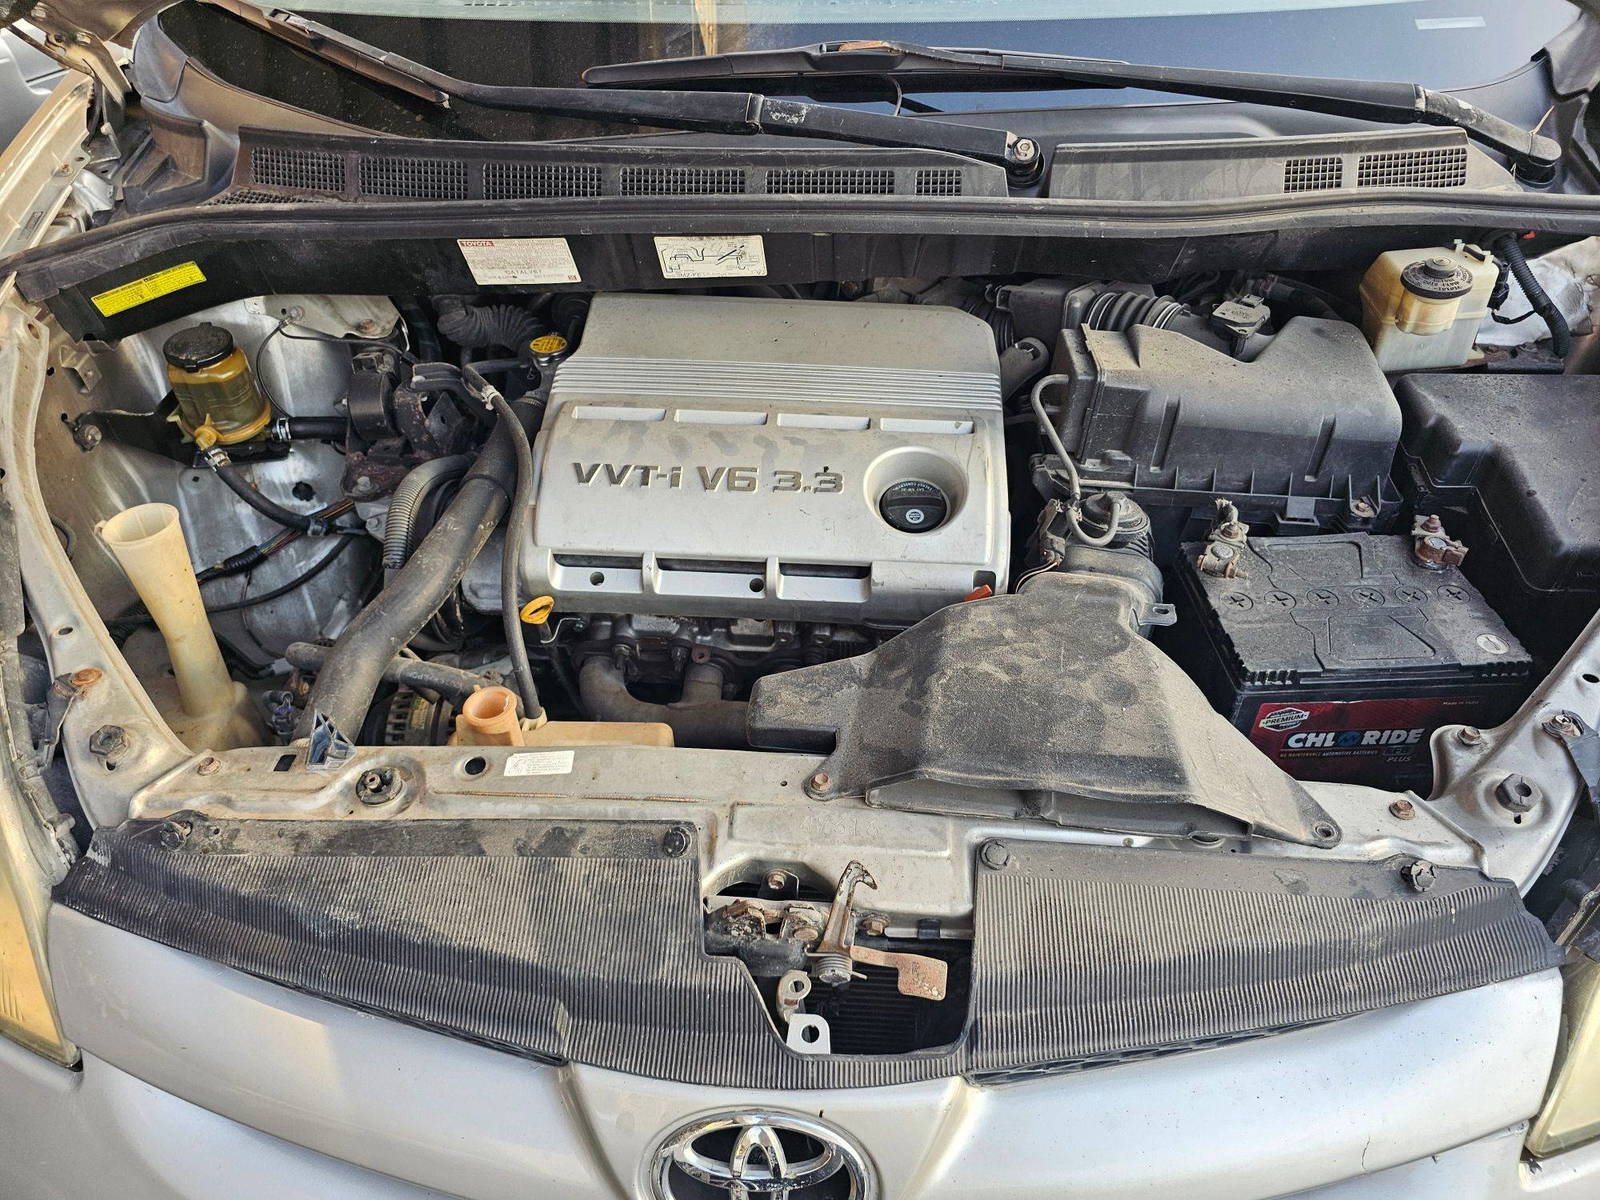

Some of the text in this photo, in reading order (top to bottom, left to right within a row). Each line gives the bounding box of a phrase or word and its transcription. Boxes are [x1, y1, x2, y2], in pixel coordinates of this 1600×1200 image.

[572, 462, 846, 494] VVT-i V6 3.3
[1265, 713, 1305, 725] PREMIUM
